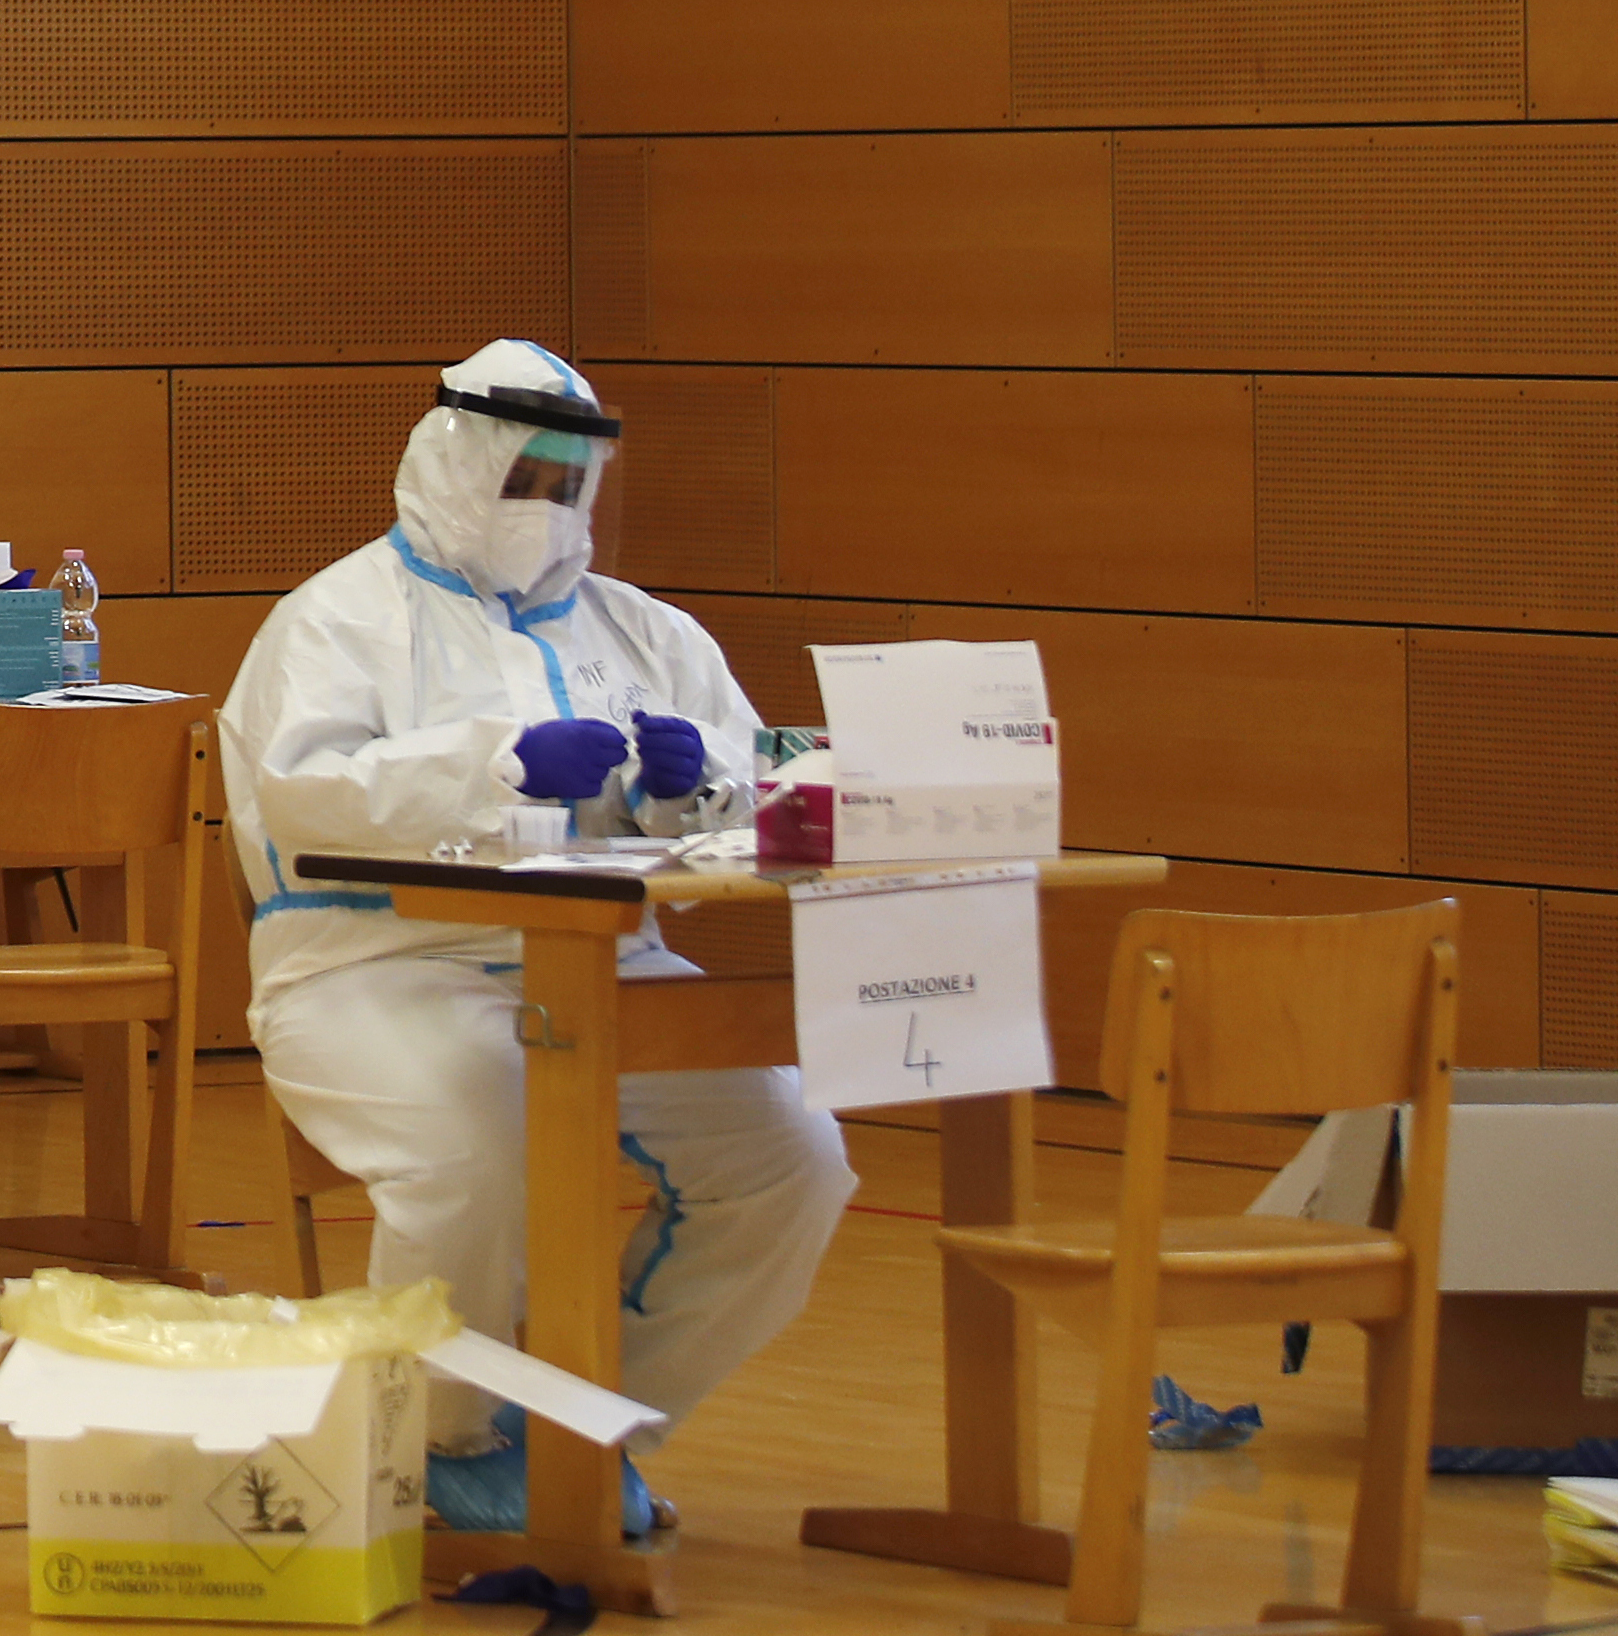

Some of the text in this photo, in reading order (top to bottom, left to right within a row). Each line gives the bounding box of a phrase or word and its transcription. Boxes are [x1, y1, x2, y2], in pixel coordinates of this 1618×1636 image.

[982, 722, 1040, 738] COVID-19
[858, 973, 975, 1000] POSTAZIONE 4
[903, 1011, 942, 1087] 4
